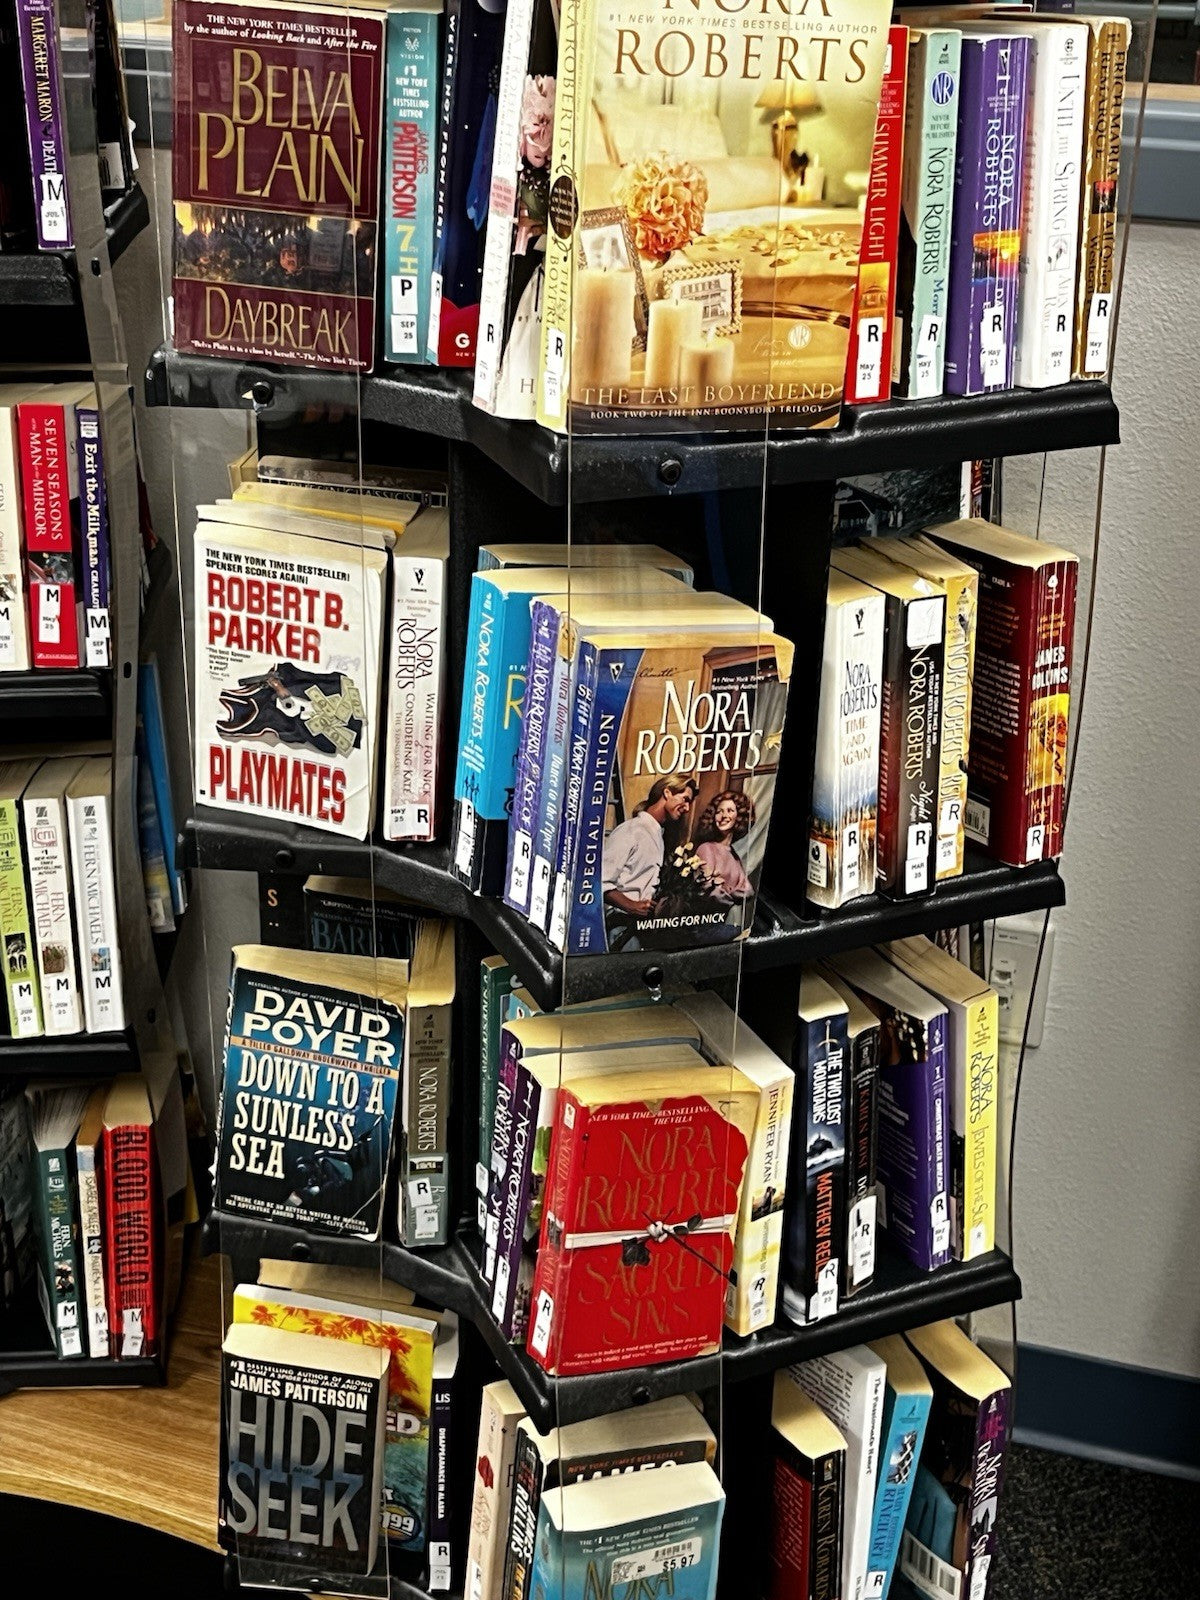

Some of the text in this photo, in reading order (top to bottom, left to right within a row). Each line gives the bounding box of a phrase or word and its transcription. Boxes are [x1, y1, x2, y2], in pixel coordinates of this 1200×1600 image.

[184, 22, 194, 34] by
[196, 23, 209, 34] the
[211, 26, 238, 37] author
[240, 29, 250, 38] of
[251, 29, 284, 43] Looking
[286, 32, 304, 43] Back
[307, 34, 322, 45] and
[323, 37, 344, 48] After
[361, 40, 378, 51] Fire
[207, 14, 358, 38] THE NEW YORK TIMES BESTSELLER
[610, 14, 878, 34] #1 NEW YORK TIMES BESTSELLING AUTHOR
[31, 16, 54, 122] MARGARET MARON
[395, 77, 427, 87] NEW YORK
[404, 65, 417, 76] #1
[613, 28, 870, 83] ROBERTS
[232, 48, 361, 136] BELVA
[393, 98, 430, 109] BESTSELLING
[399, 109, 423, 119] AUTHOR
[1095, 52, 1110, 159] REMARQUE
[1107, 50, 1126, 177] ERICH MARIA
[197, 112, 365, 207] PLAIN
[393, 121, 418, 220] PATTERSON
[870, 122, 890, 202] SUMMER
[927, 147, 947, 197] NORA
[983, 118, 1001, 227] ROBERTS
[1001, 135, 1015, 209] NORA
[868, 207, 886, 258] LIGHT
[923, 203, 944, 275] ROBERTS
[401, 280, 413, 296] P
[205, 286, 351, 355] DAYBREAK
[868, 324, 879, 342] R
[581, 382, 835, 405] THE LAST BOYFRIEND
[591, 411, 619, 420] BOOK
[624, 410, 648, 418] TWO
[650, 409, 663, 417] OF
[667, 409, 687, 417] THE
[691, 408, 710, 416] INN
[779, 405, 823, 413] TRILOGY
[30, 432, 43, 466] MAN
[84, 443, 97, 475] Exit
[44, 418, 63, 541] SEVEN SEASONS
[86, 477, 98, 503] the
[32, 479, 47, 537] MIRROR
[87, 504, 100, 568] Milkman
[206, 549, 350, 581] THE NEW YORK TIMES BESTSELLER!
[206, 560, 309, 585] SPENSER SCORES AGAIN!
[207, 571, 350, 631] ROBERT B.
[208, 609, 321, 663] PARKER
[397, 617, 417, 690] ROBERTS
[415, 627, 437, 679] NORA
[1035, 645, 1066, 668] JAMES
[472, 612, 495, 740] NORA ROBERTS
[845, 661, 870, 690] NORA
[942, 641, 970, 765] NORA ROBERTS
[526, 665, 551, 757] NORA ROBERTS
[554, 672, 572, 747] Nora Roberts
[660, 680, 750, 734] NORA
[845, 716, 868, 734] TIME
[905, 644, 930, 779] NORA ROBERTS
[403, 692, 415, 794] CONSIDERING KATE
[421, 692, 436, 798] WAITING FOR NICK
[634, 730, 763, 775] ROBERTS
[843, 747, 872, 766] AGAIN
[209, 744, 347, 824] PLAYMATES
[567, 734, 588, 824] NORA ROBERTS
[579, 714, 615, 905] SPECIAL EDITION
[35, 879, 52, 939] MICHAELS
[50, 892, 66, 922] FERN
[84, 843, 101, 945] FERN MICHAELS
[636, 912, 725, 930] WAITING FOR NICK
[242, 1012, 395, 1067] POYER
[254, 989, 391, 1039] DAVID
[238, 1050, 386, 1115] DOWN TO A
[249, 1040, 272, 1050] TILLER
[273, 1043, 311, 1059] GALLOWAY
[312, 1053, 359, 1070] UNDERWATER
[360, 1063, 391, 1076] THRILLER
[419, 1066, 438, 1102] NORA
[980, 1054, 994, 1113] NORA
[813, 1060, 827, 1124] MOUNTAINS
[827, 1048, 844, 1126] THE TWO LOST
[970, 1052, 982, 1124] ROBERTS
[233, 1091, 356, 1151] SUNLESS
[417, 1103, 437, 1151] ROBERTS
[654, 1115, 693, 1125] THE VILLA
[765, 1088, 779, 1150] JENNIFER
[230, 1133, 285, 1179] SEA
[617, 1125, 717, 1176] NORA
[763, 1151, 774, 1183] RYAN
[112, 1131, 149, 1286] BLOOD WORLD
[417, 1182, 428, 1195] R
[579, 1166, 737, 1228] ROBERTS
[816, 1171, 833, 1239] MATTHEW
[578, 1245, 722, 1304] SACRED
[602, 1298, 689, 1344] SINS
[230, 1360, 246, 1372] #1
[247, 1363, 294, 1376] BESTSELLING
[297, 1369, 329, 1381] AUTHOR
[346, 1377, 373, 1388] ALONG
[230, 1372, 368, 1411] JAMES PATTERSON
[247, 1369, 269, 1378] CAME
[277, 1373, 302, 1383] SPIDER
[303, 1377, 319, 1385] AND
[320, 1380, 339, 1388] JACK
[341, 1383, 357, 1391] AND
[359, 1385, 372, 1393] JILL
[229, 1389, 367, 1481] HIDE
[868, 1396, 880, 1448] Passionate
[865, 1449, 876, 1475] Heart
[227, 1461, 364, 1551] SEEK
[511, 1483, 529, 1558] ROLLINS
[872, 1488, 896, 1557] RINEHART
[523, 1505, 536, 1565] JAMES
[662, 1554, 695, 1572] $5.97
